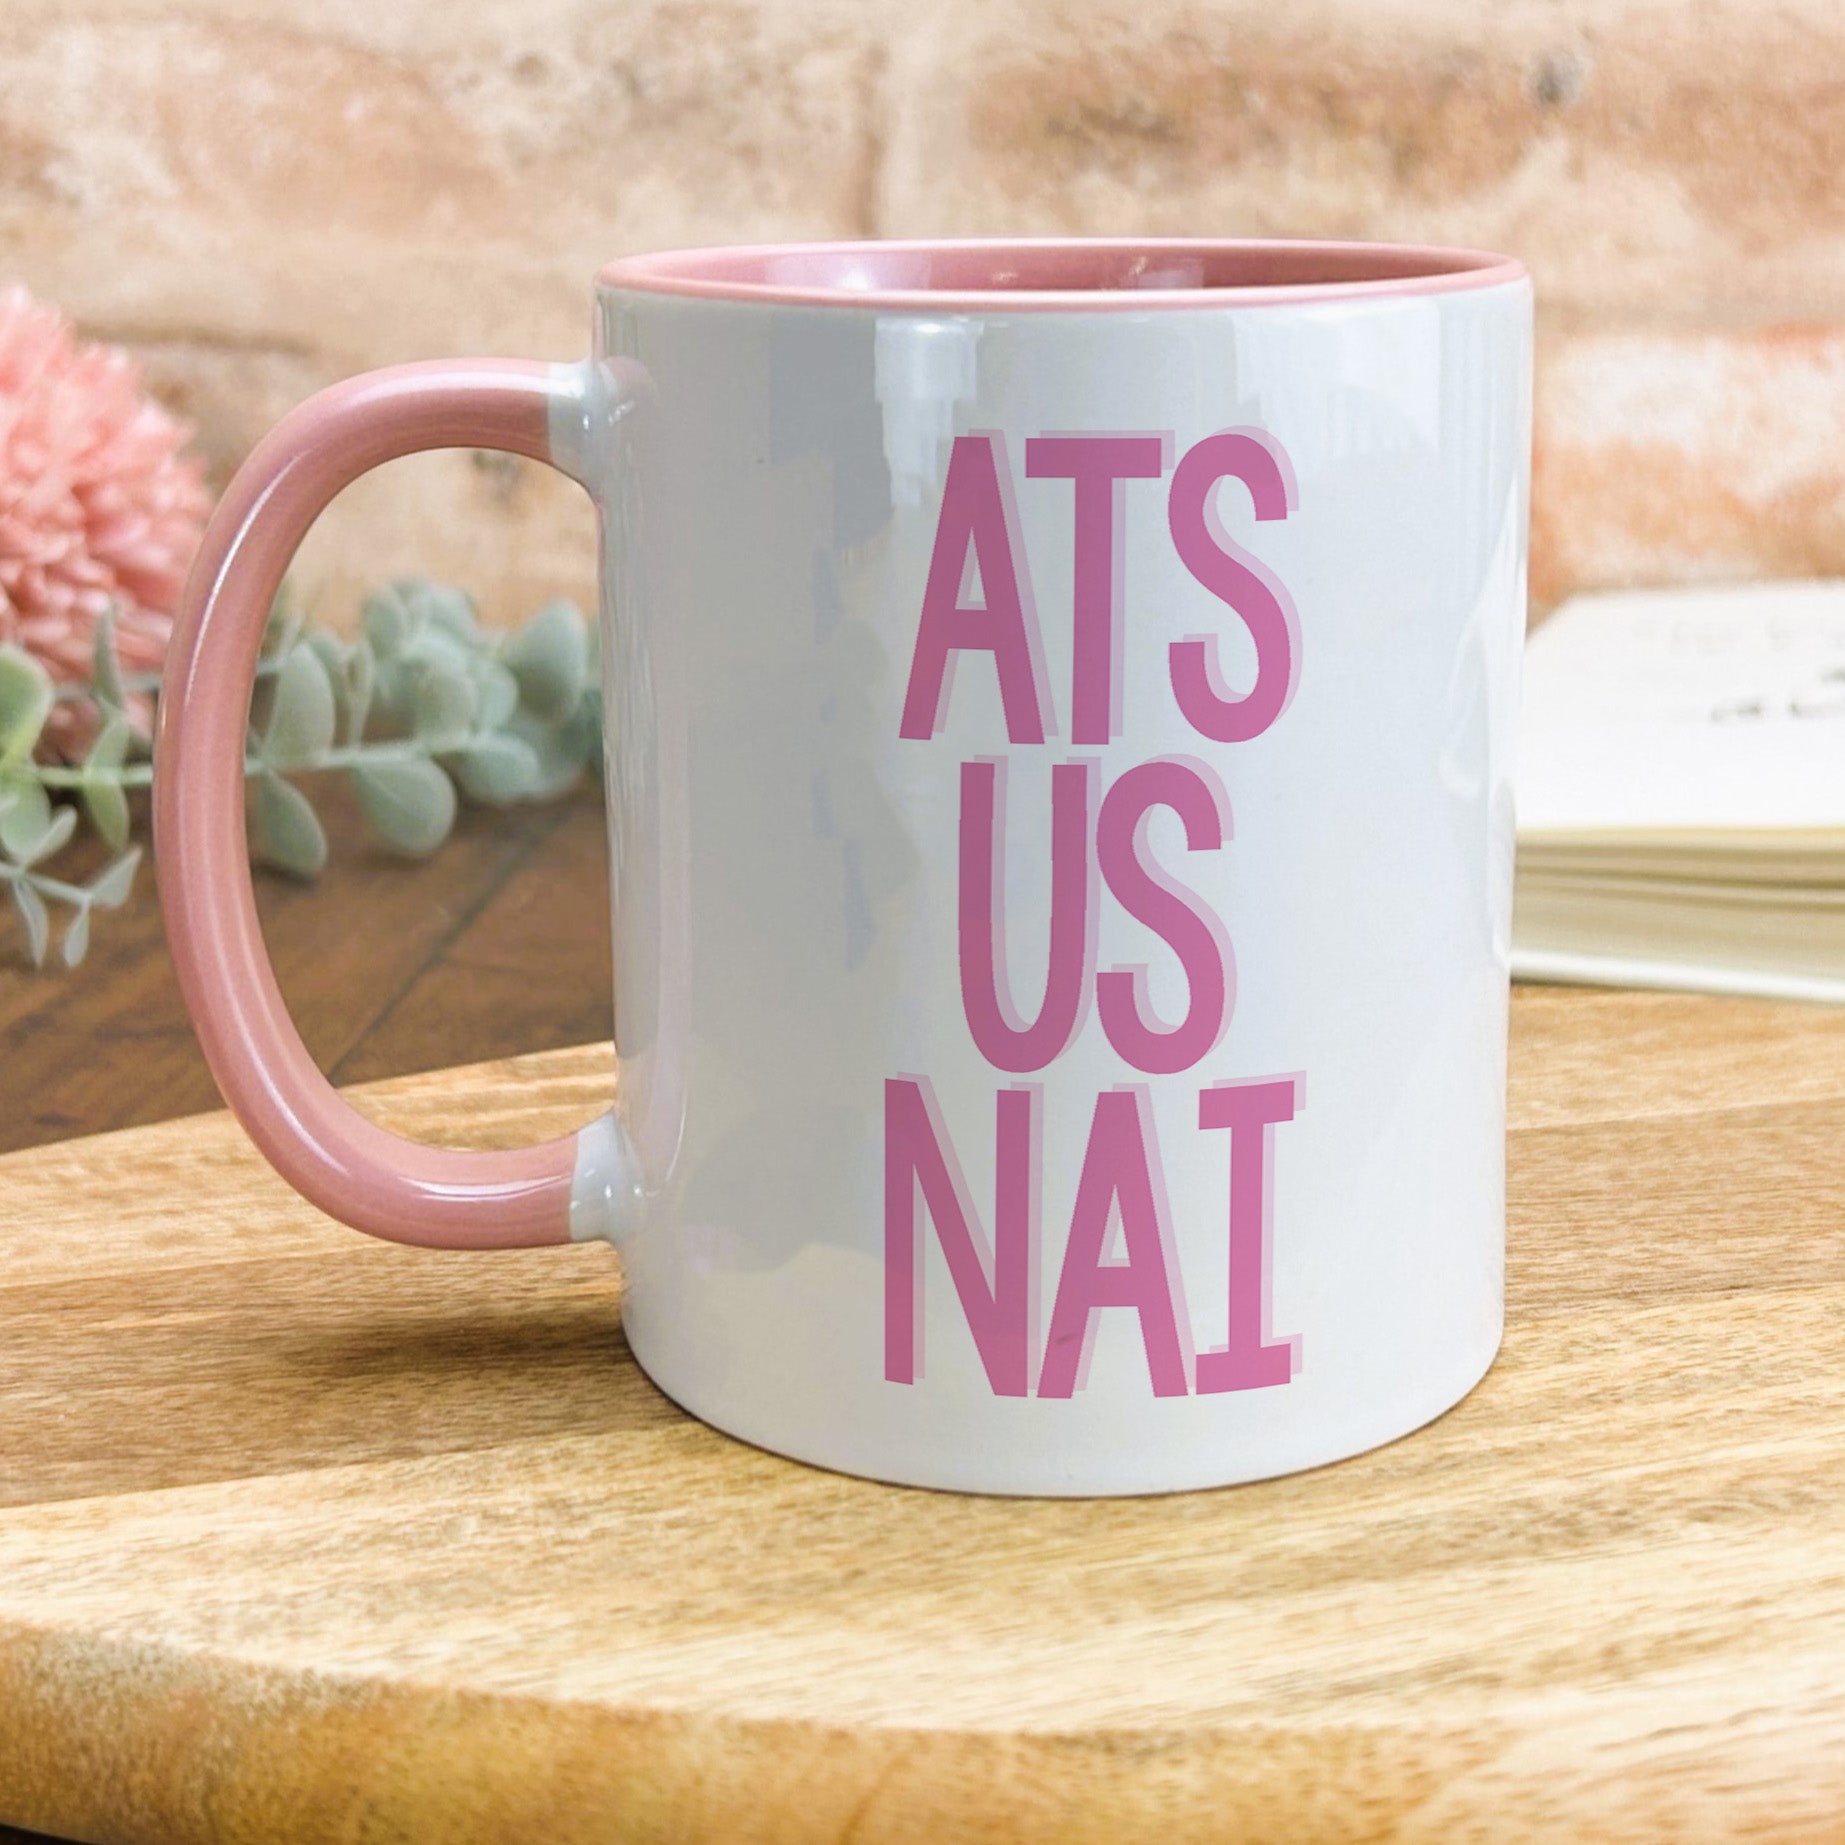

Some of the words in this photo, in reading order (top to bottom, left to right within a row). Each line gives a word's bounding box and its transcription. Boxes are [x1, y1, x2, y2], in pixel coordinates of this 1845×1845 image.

[899, 428, 1300, 745] ATS
[958, 756, 1235, 1075] US
[885, 1071, 1304, 1399] NAI
